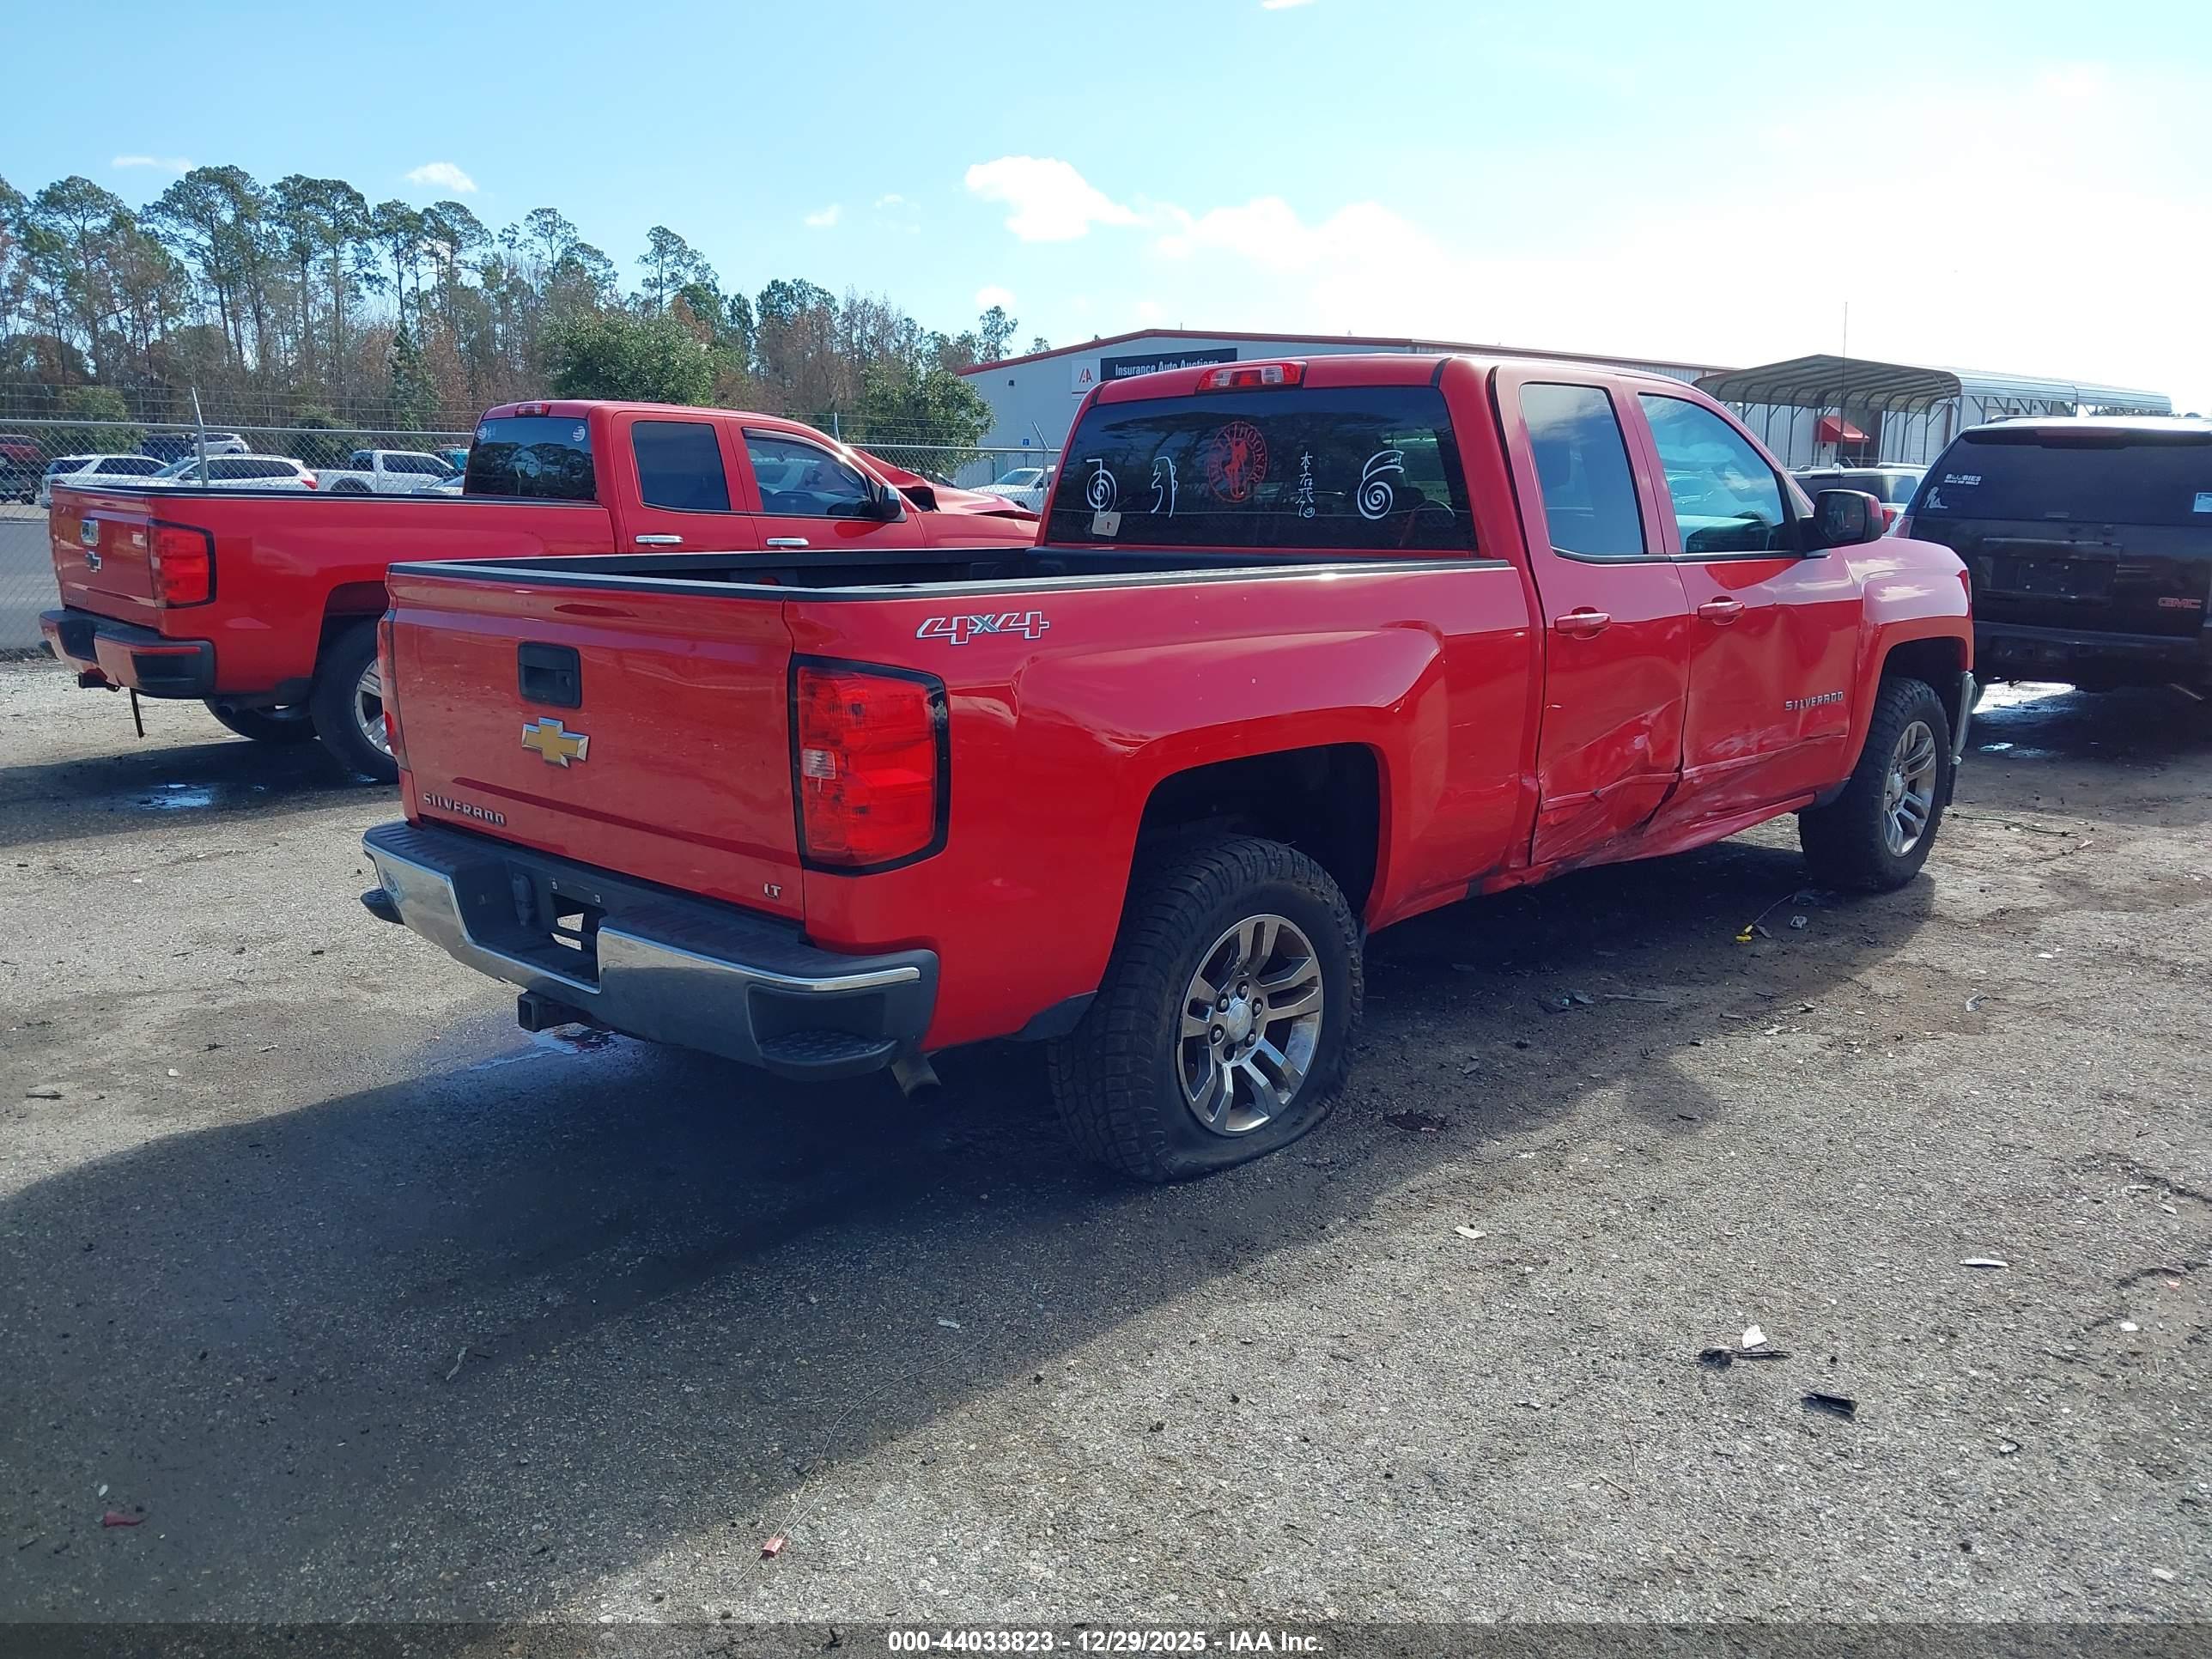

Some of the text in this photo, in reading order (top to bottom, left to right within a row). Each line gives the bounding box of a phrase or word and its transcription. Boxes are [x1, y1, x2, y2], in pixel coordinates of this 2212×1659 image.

[1115, 363, 1156, 377] Insurance
[1158, 361, 1177, 372] Auto
[1238, 426, 1266, 483] HOOKER
[2158, 597, 2202, 609] GMC
[1785, 691, 1844, 711] SILVERADO
[422, 792, 507, 825] SILVERADO
[763, 883, 781, 899] LT
